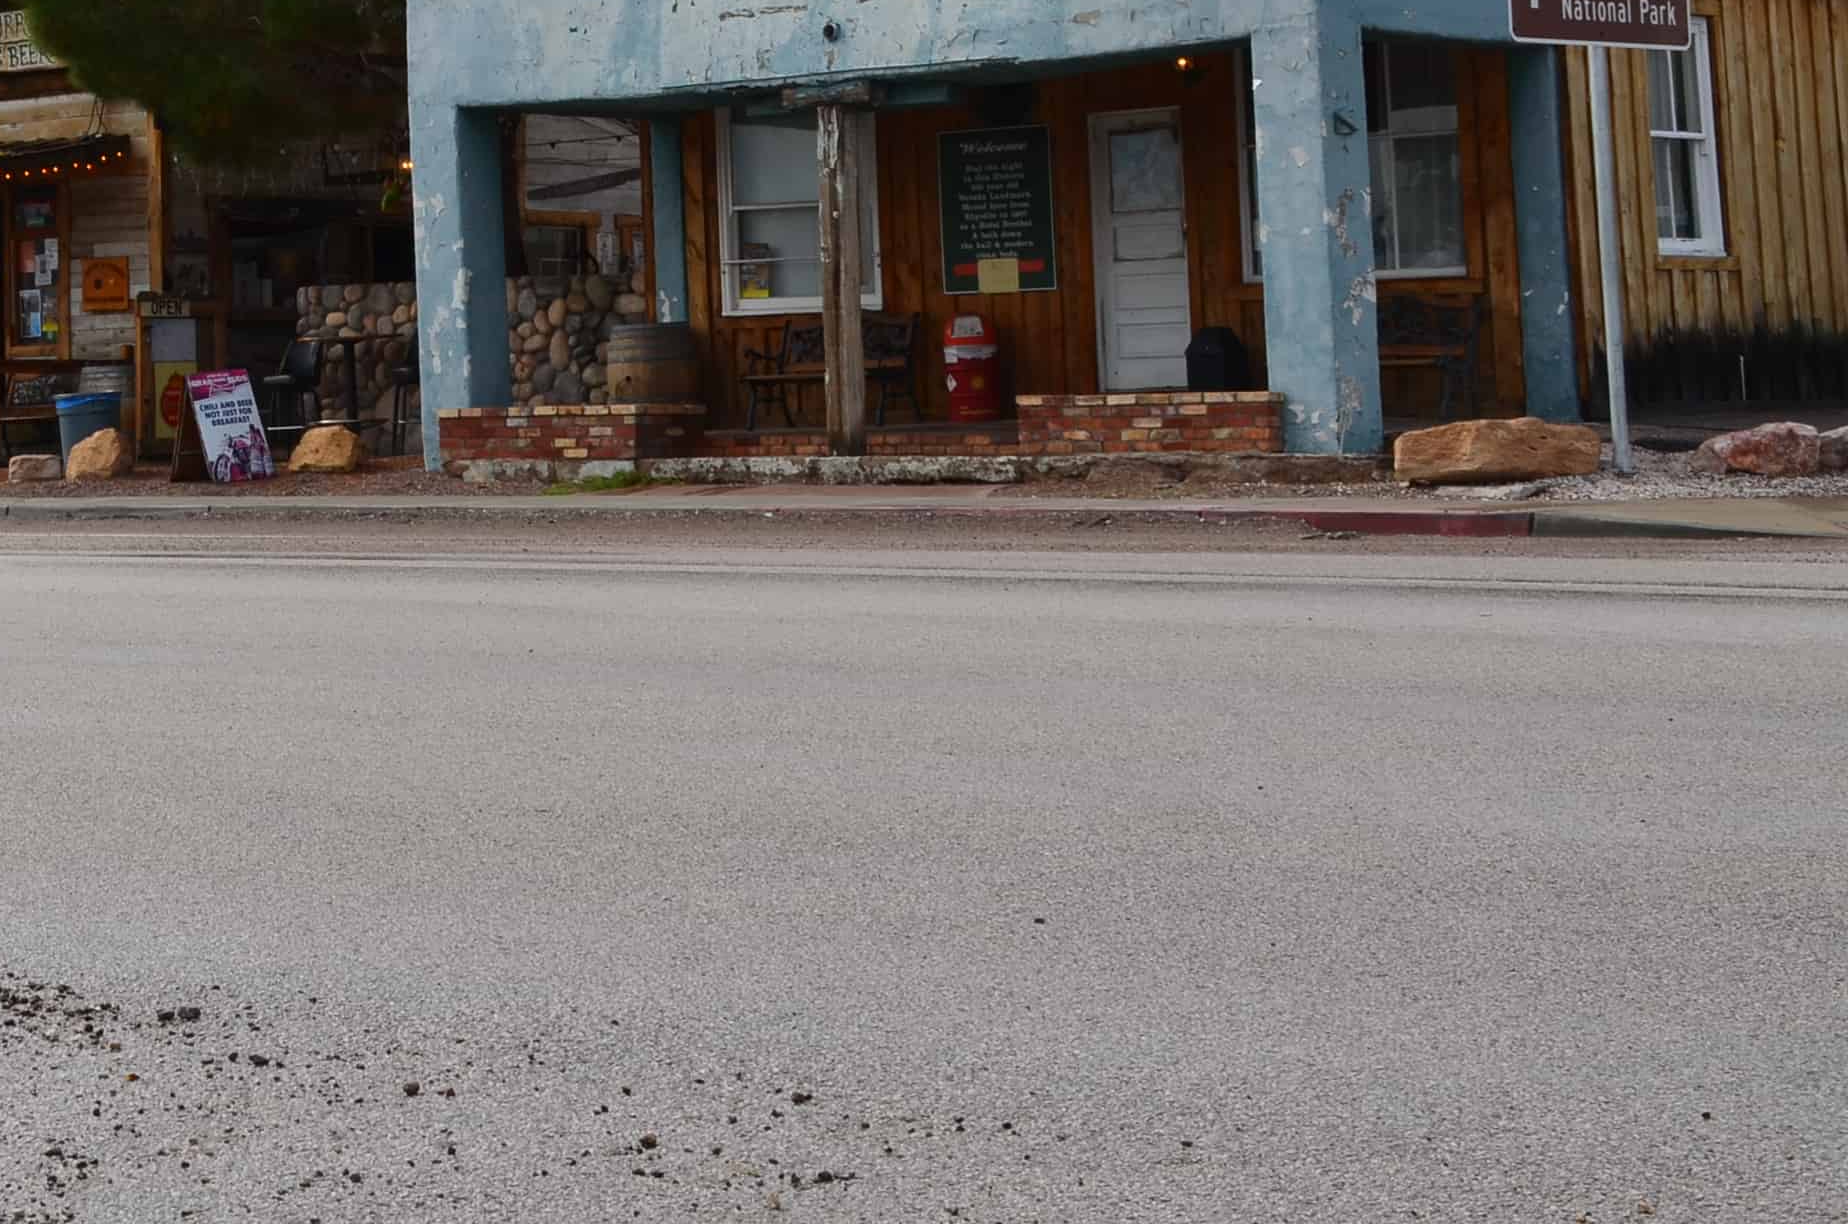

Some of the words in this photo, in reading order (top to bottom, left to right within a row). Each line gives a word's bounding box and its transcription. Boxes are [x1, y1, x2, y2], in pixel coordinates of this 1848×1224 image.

[151, 299, 183, 314] OPEN
[199, 402, 218, 412] CHILI
[220, 401, 235, 410] AND
[205, 410, 220, 419] NOT
[222, 409, 237, 417] JUST
